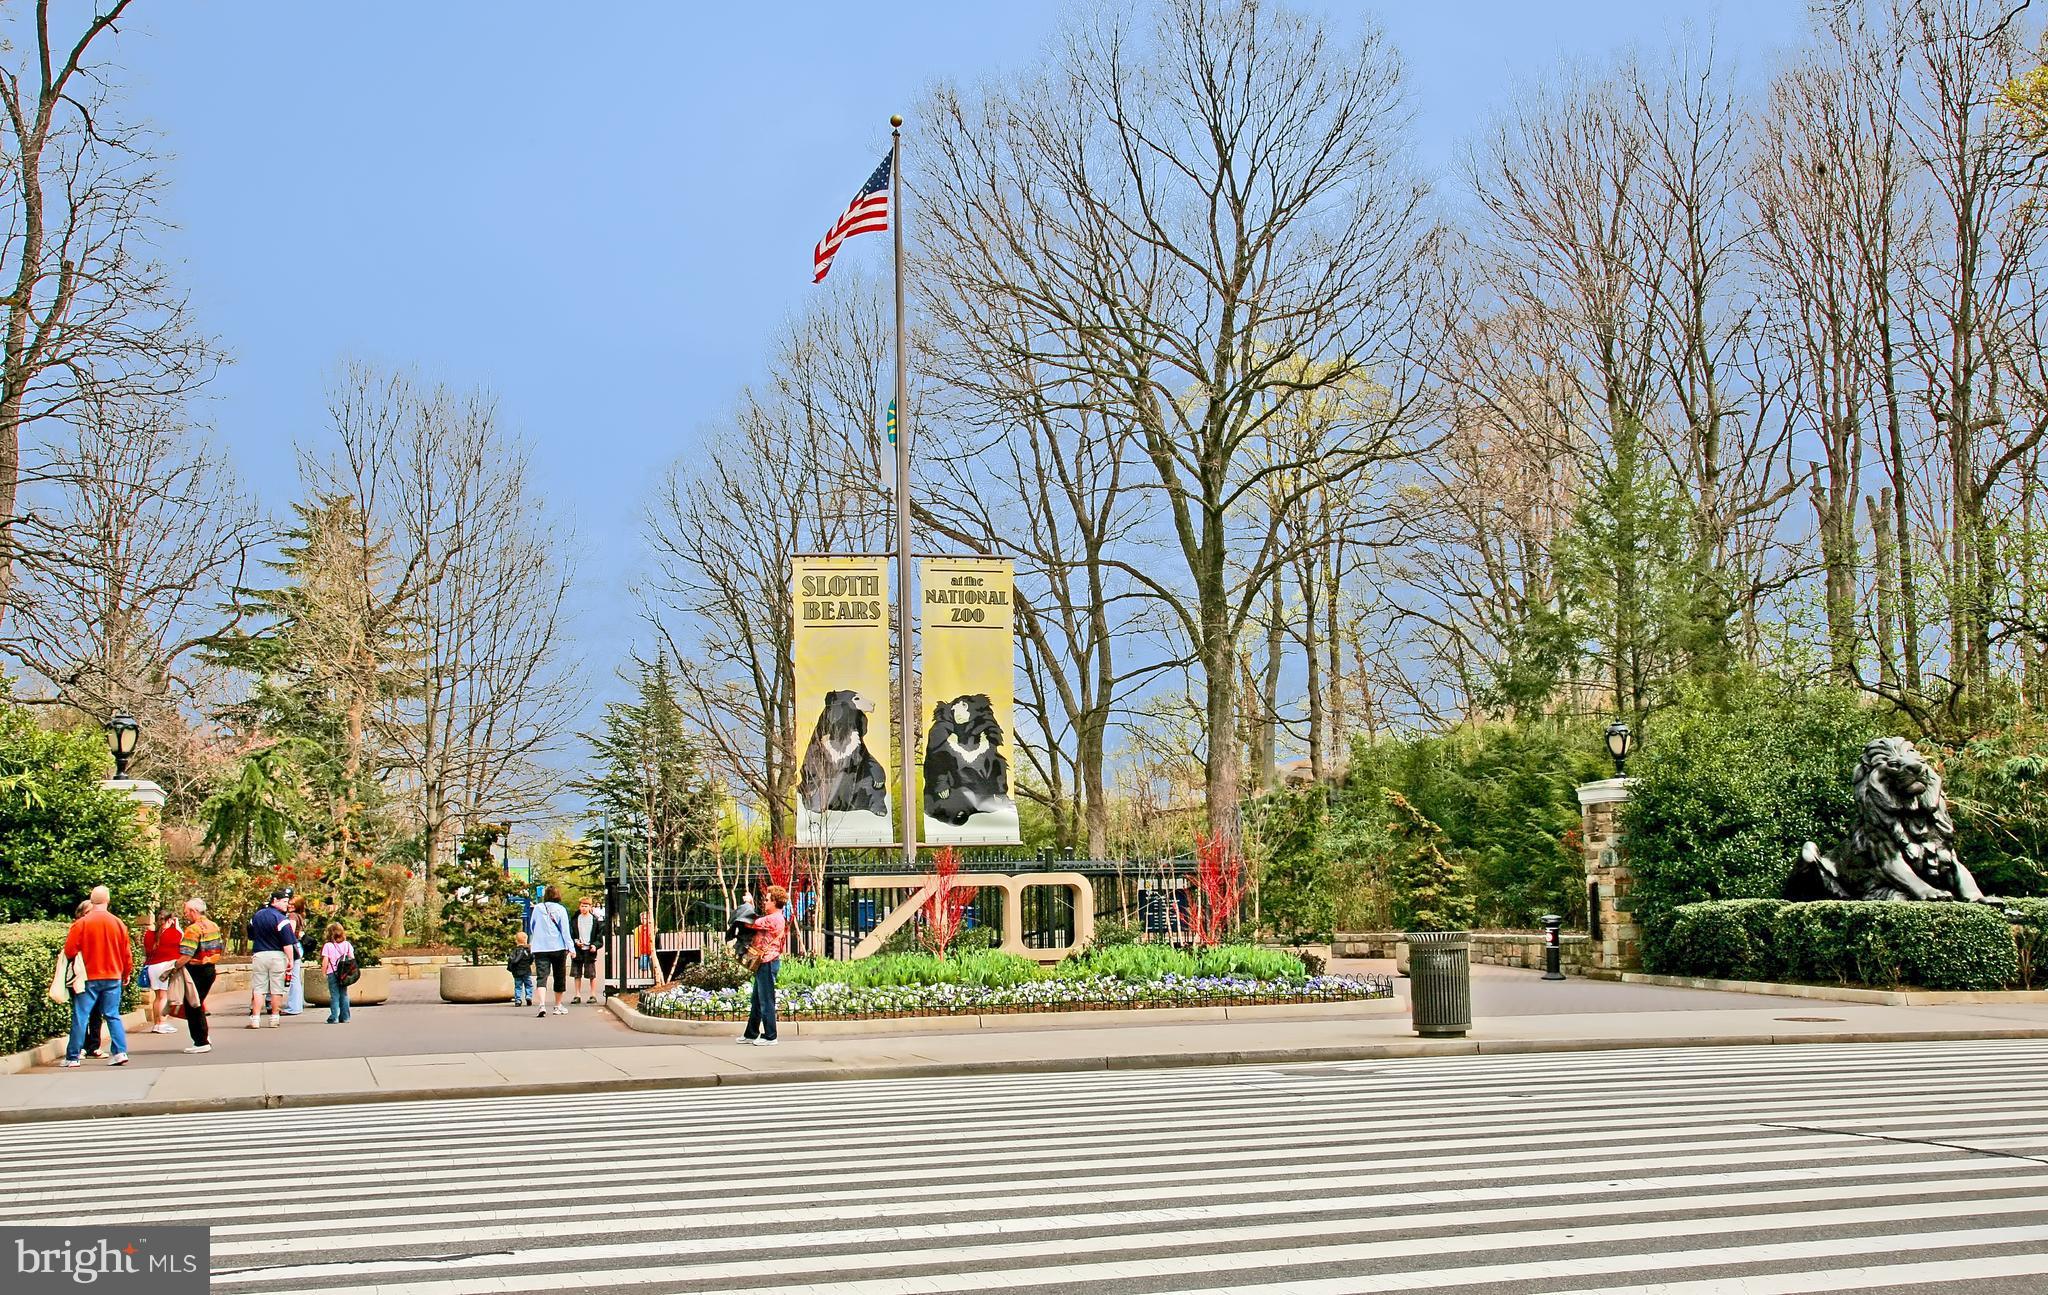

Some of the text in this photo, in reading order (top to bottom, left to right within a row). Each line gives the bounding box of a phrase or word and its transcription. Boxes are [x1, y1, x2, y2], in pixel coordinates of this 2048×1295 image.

[801, 575, 880, 597] SLOTH
[950, 575, 984, 587] at the
[925, 589, 1009, 605] NATIONAL
[802, 600, 881, 620] BEARS
[951, 608, 985, 623] ZOO
